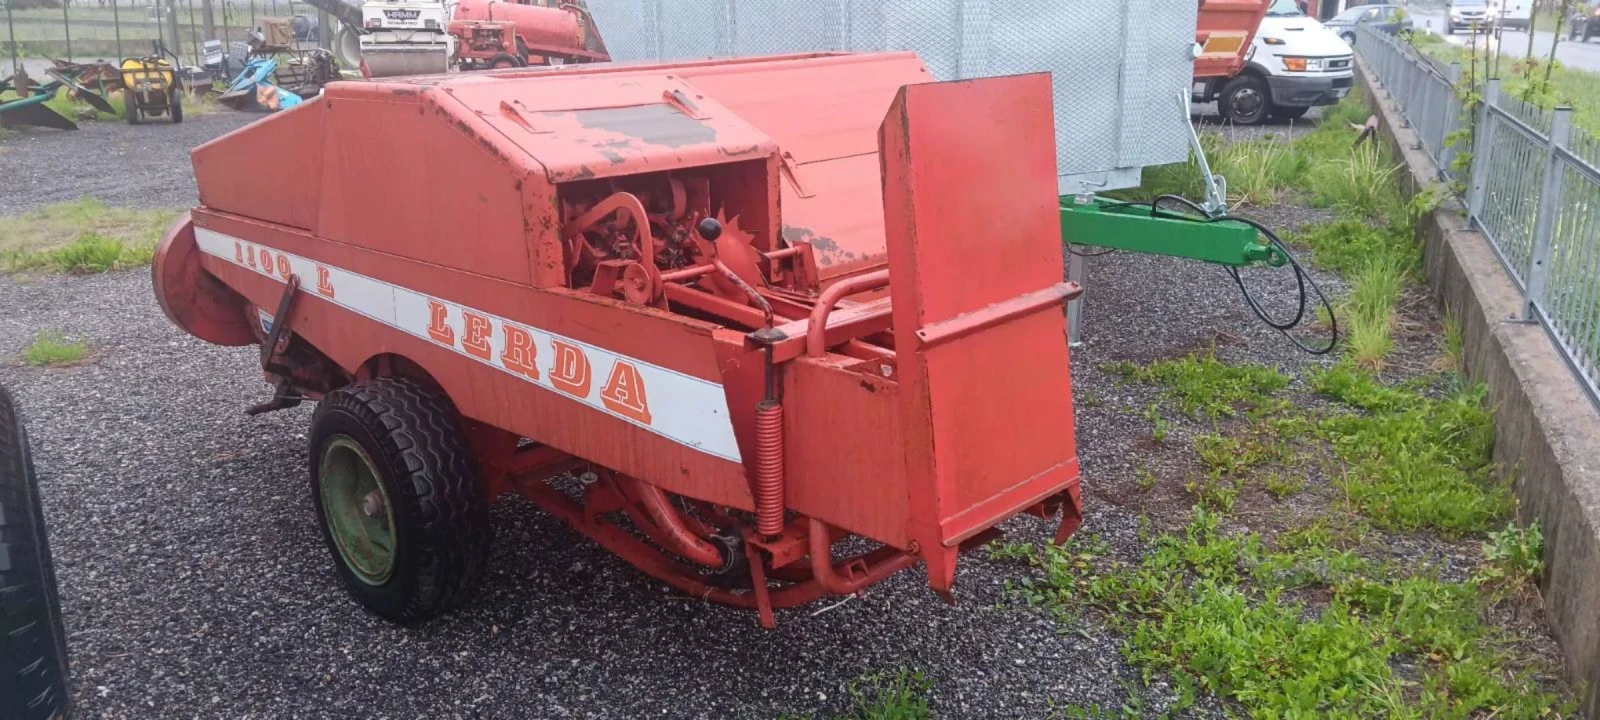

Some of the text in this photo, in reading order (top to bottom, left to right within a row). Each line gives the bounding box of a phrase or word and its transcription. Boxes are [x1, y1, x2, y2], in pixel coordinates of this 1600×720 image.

[387, 11, 417, 19] HAMM
[234, 241, 652, 426] 1100 L LERDA
